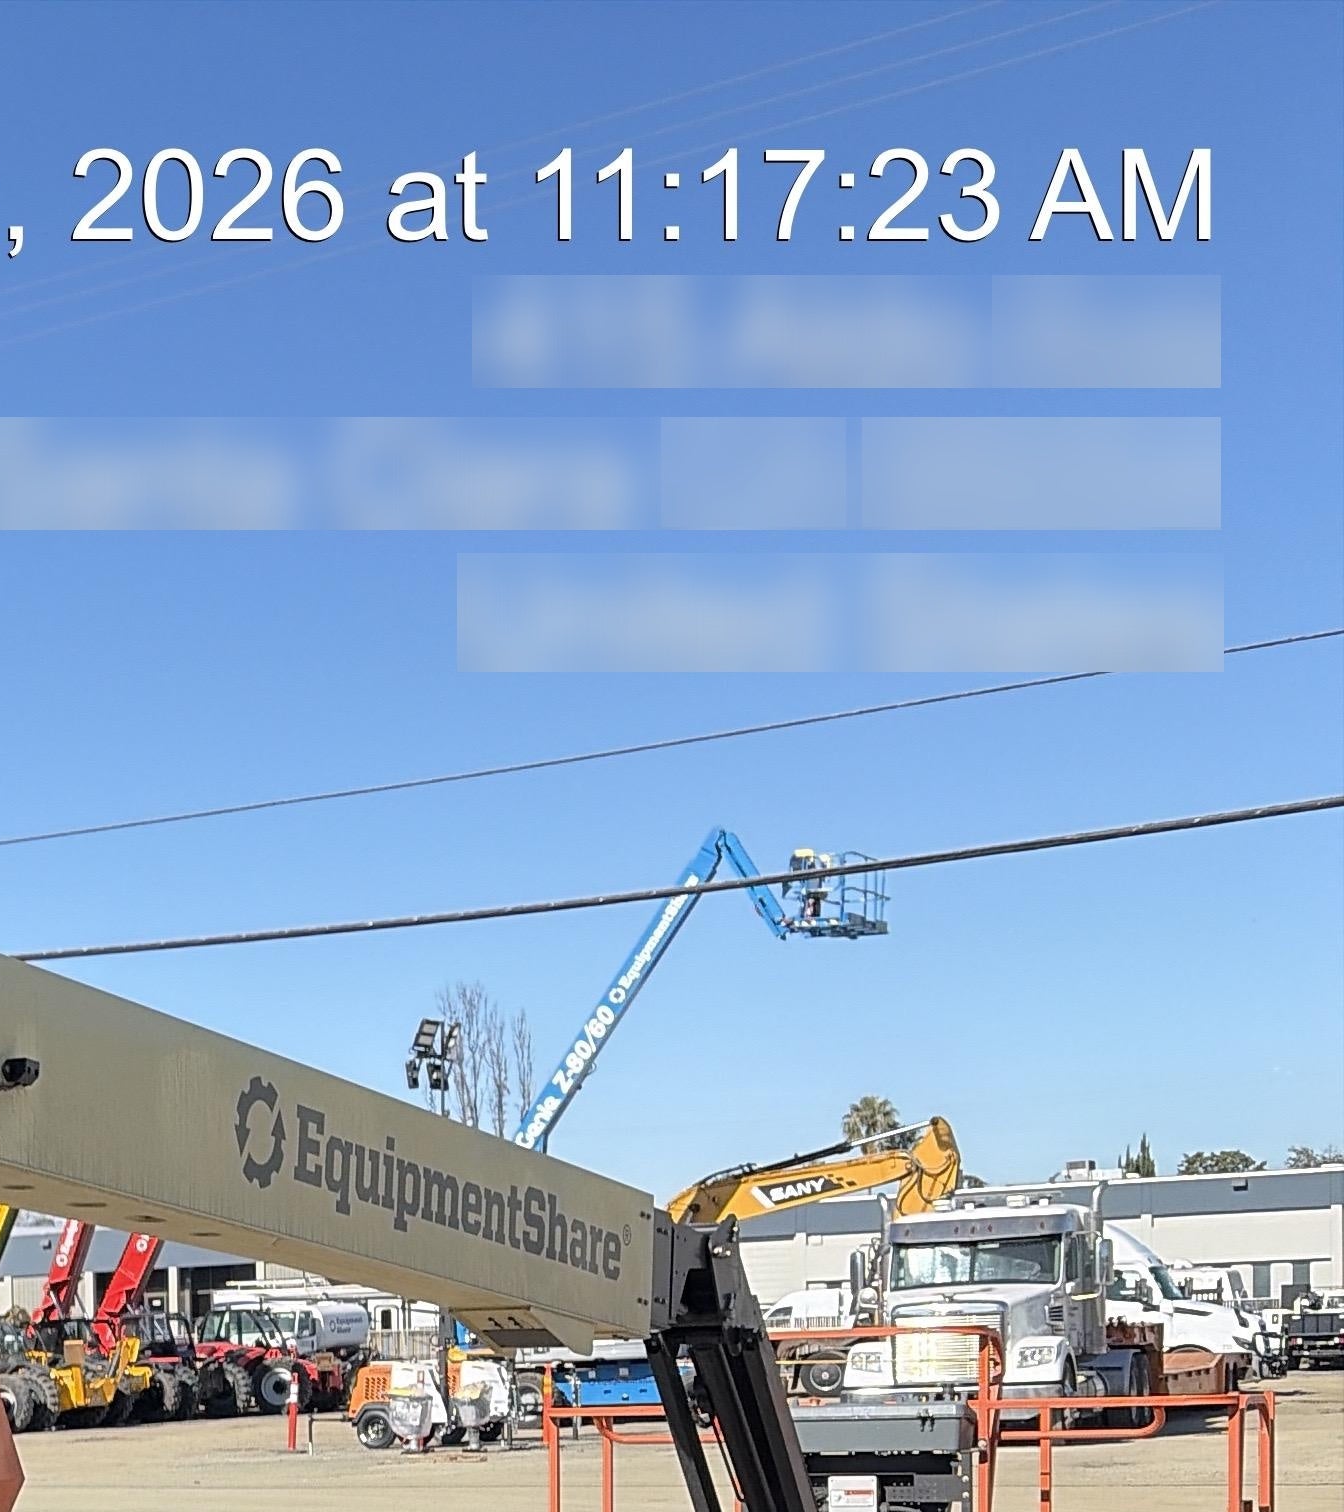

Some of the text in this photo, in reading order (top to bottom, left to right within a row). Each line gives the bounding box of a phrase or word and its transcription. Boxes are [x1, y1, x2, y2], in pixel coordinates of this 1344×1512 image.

[515, 1004, 615, 1149] Genie Z-80/60
[294, 1104, 622, 1281] EquipmentShare
[770, 1177, 825, 1201] SANY
